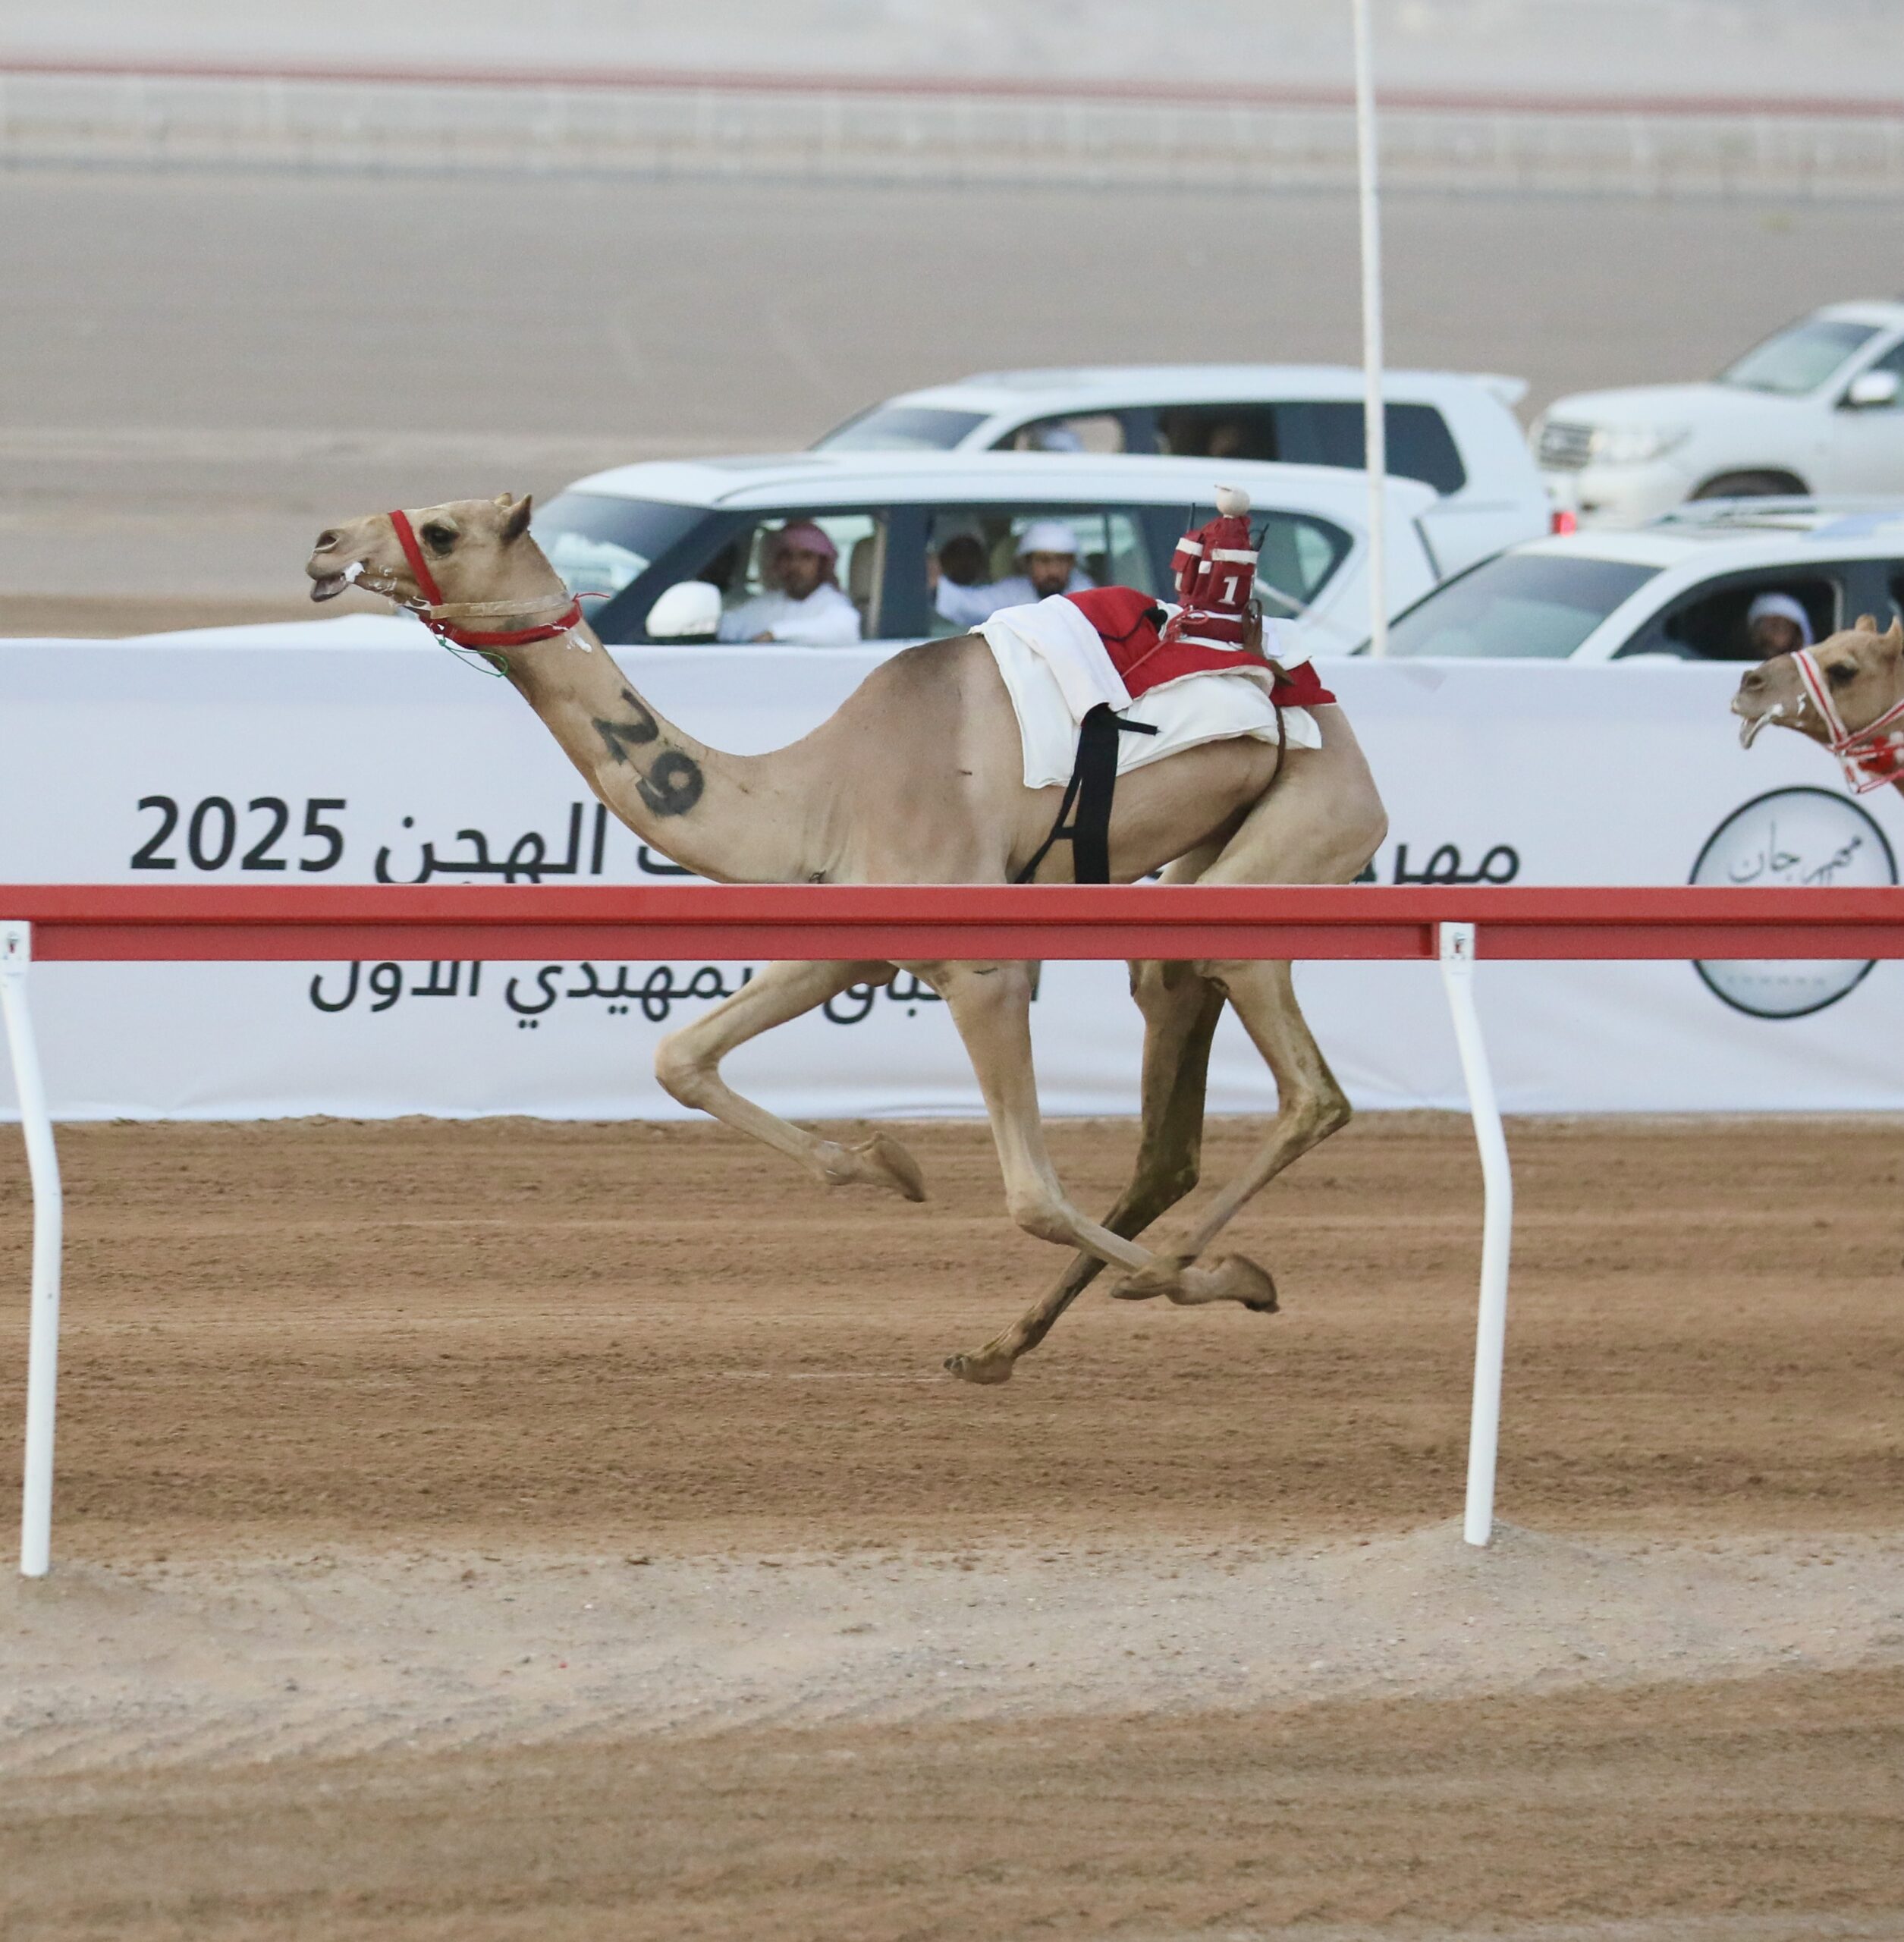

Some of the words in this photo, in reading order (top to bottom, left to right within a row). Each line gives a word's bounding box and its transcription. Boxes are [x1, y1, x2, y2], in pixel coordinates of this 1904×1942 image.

[1217, 577, 1239, 605] 1
[592, 688, 705, 818] 29
[130, 795, 347, 872] 2025
